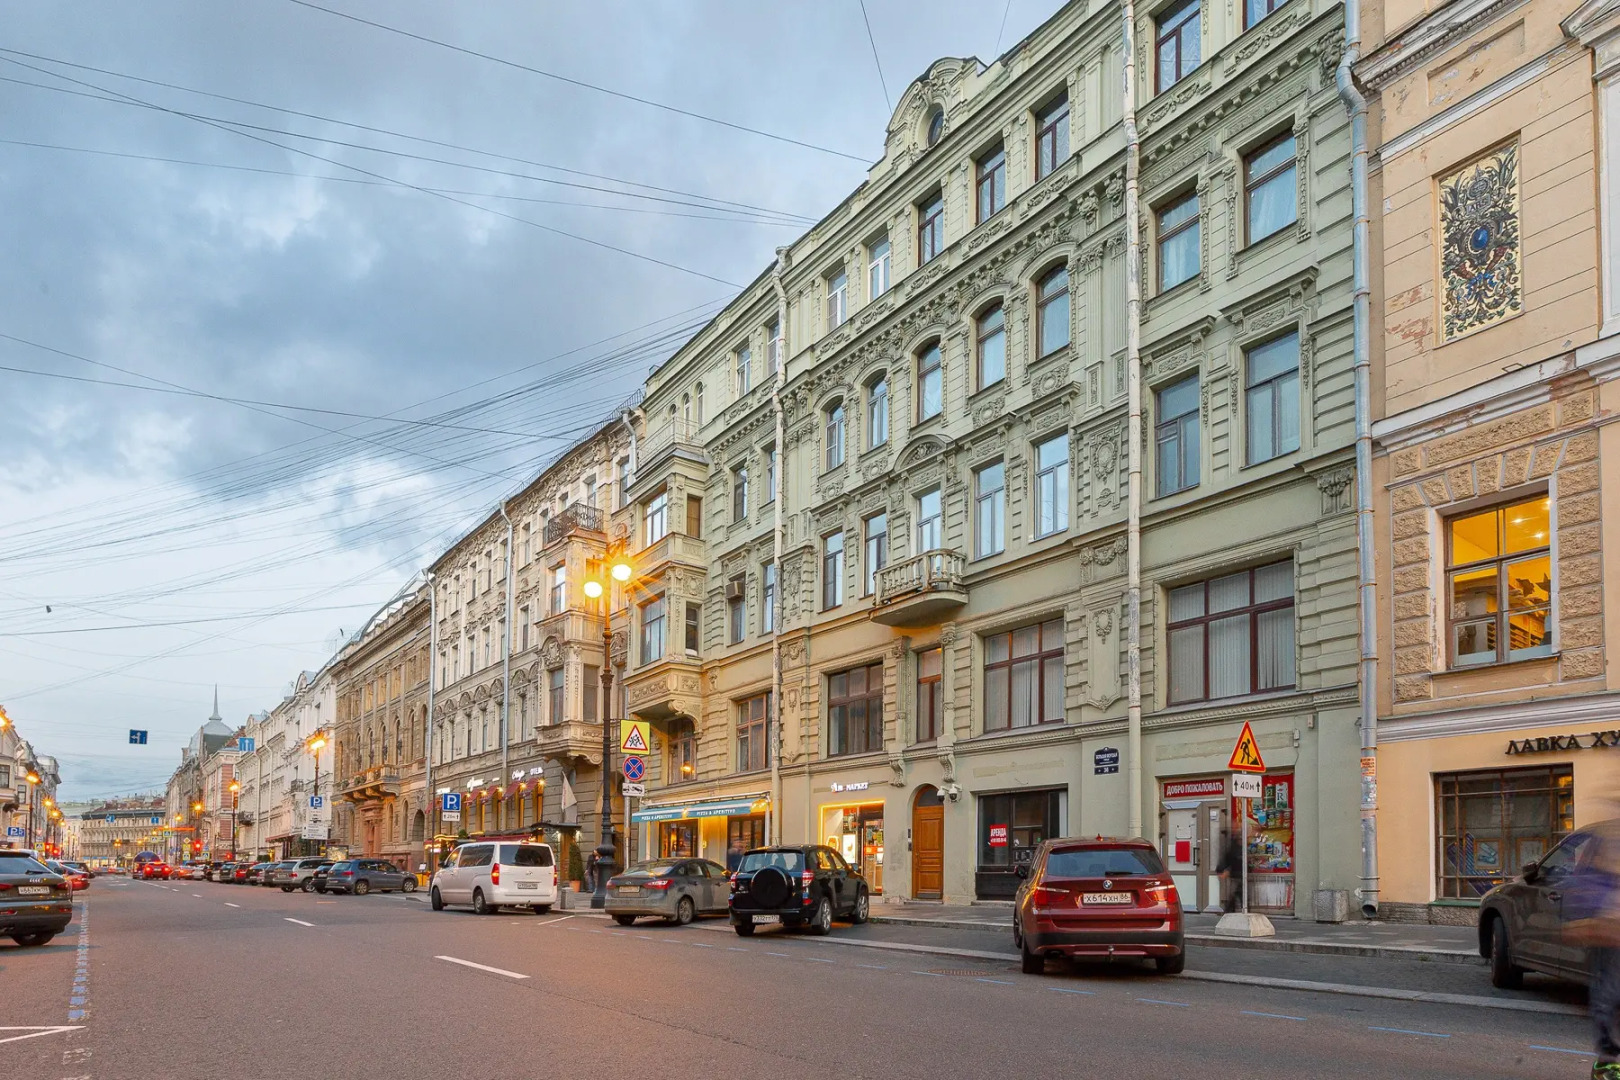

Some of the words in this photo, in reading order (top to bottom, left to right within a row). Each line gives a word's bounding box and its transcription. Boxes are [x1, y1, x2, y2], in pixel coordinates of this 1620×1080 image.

[1505, 734, 1584, 754] ЛАВКА
[1166, 785, 1184, 796] ДОБРО
[1185, 782, 1223, 794] ПОЖАЛОВАТЬ
[447, 795, 457, 809] P
